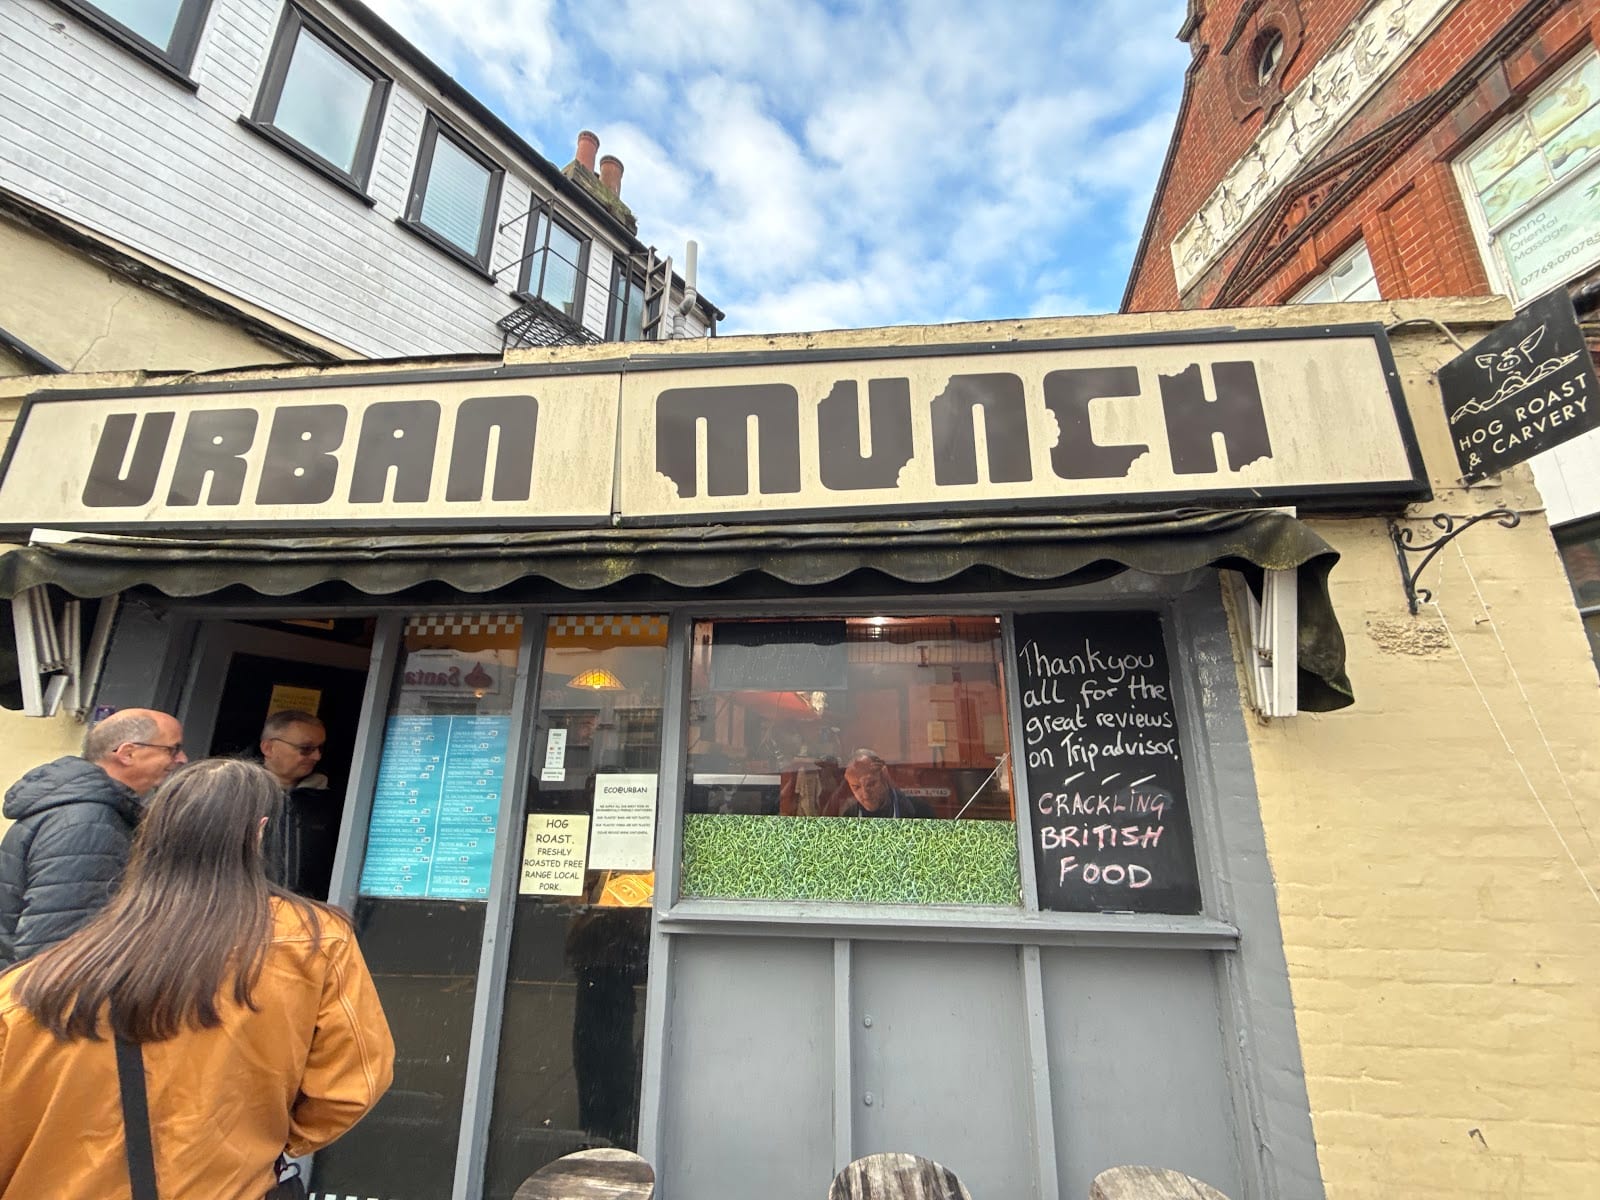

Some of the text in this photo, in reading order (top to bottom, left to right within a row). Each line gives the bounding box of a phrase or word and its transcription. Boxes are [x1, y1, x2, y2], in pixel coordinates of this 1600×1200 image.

[1509, 212, 1546, 242] Anna
[1511, 216, 1558, 251] Oriental
[1514, 224, 1568, 261] Massage
[1459, 373, 1587, 451] HOG ROAST
[82, 361, 1273, 507] URBAN MUNCH
[1469, 396, 1587, 467] & CARVERY
[1024, 675, 1167, 708] all for the
[1026, 704, 1173, 745] great reviews
[1029, 749, 1054, 768] on
[536, 833, 575, 844] ROAST.
[546, 819, 569, 828] HOG
[524, 859, 584, 868] ROASTED FREE
[537, 847, 572, 856] FRESHLY
[525, 871, 552, 879] RANGE
[1059, 855, 1152, 888] FOOD
